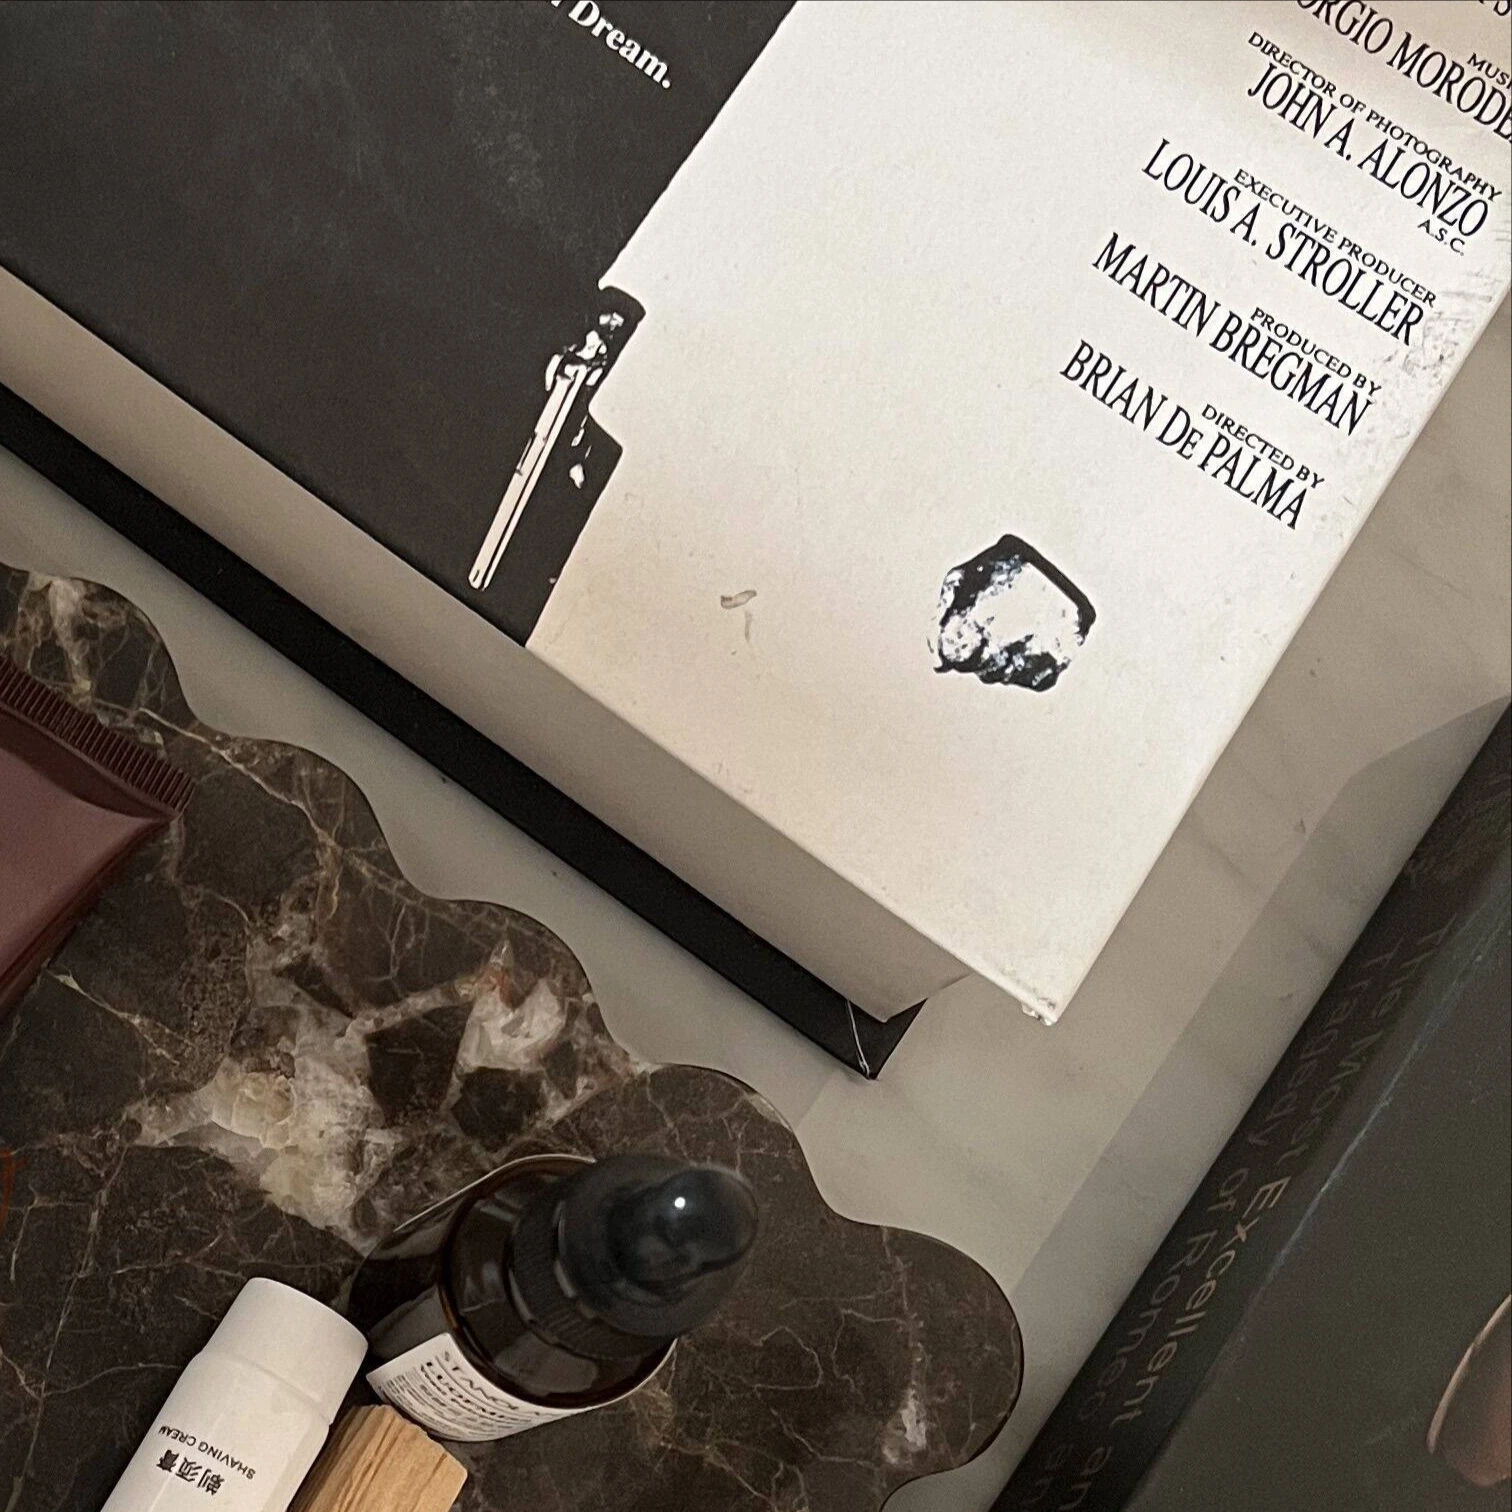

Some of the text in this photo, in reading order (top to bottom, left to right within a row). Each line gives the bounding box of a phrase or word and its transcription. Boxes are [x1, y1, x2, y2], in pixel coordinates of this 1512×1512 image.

[568, 0, 672, 89] Dream.
[1247, 62, 1489, 237] JOHN A. ALONZO
[1248, 31, 1502, 202] DIRECTOR OF PHOTOGRAPHY
[1141, 138, 1424, 347] LOUIS A. STROLLER
[1233, 168, 1437, 308] EXECUTIVE PRODUCER
[1417, 218, 1465, 256] A.S.C.
[1092, 232, 1373, 436] MARTIN BREGMAN
[1250, 306, 1382, 397] PRODUCED BY
[1060, 339, 1308, 530] BRIAN DE PALMA
[1201, 404, 1325, 490] DIRECTED BY
[1110, 1175, 1292, 1428] Excellent
[156, 1449, 226, 1496] 剃须膏
[158, 1425, 256, 1480] SHAVING CREAM
